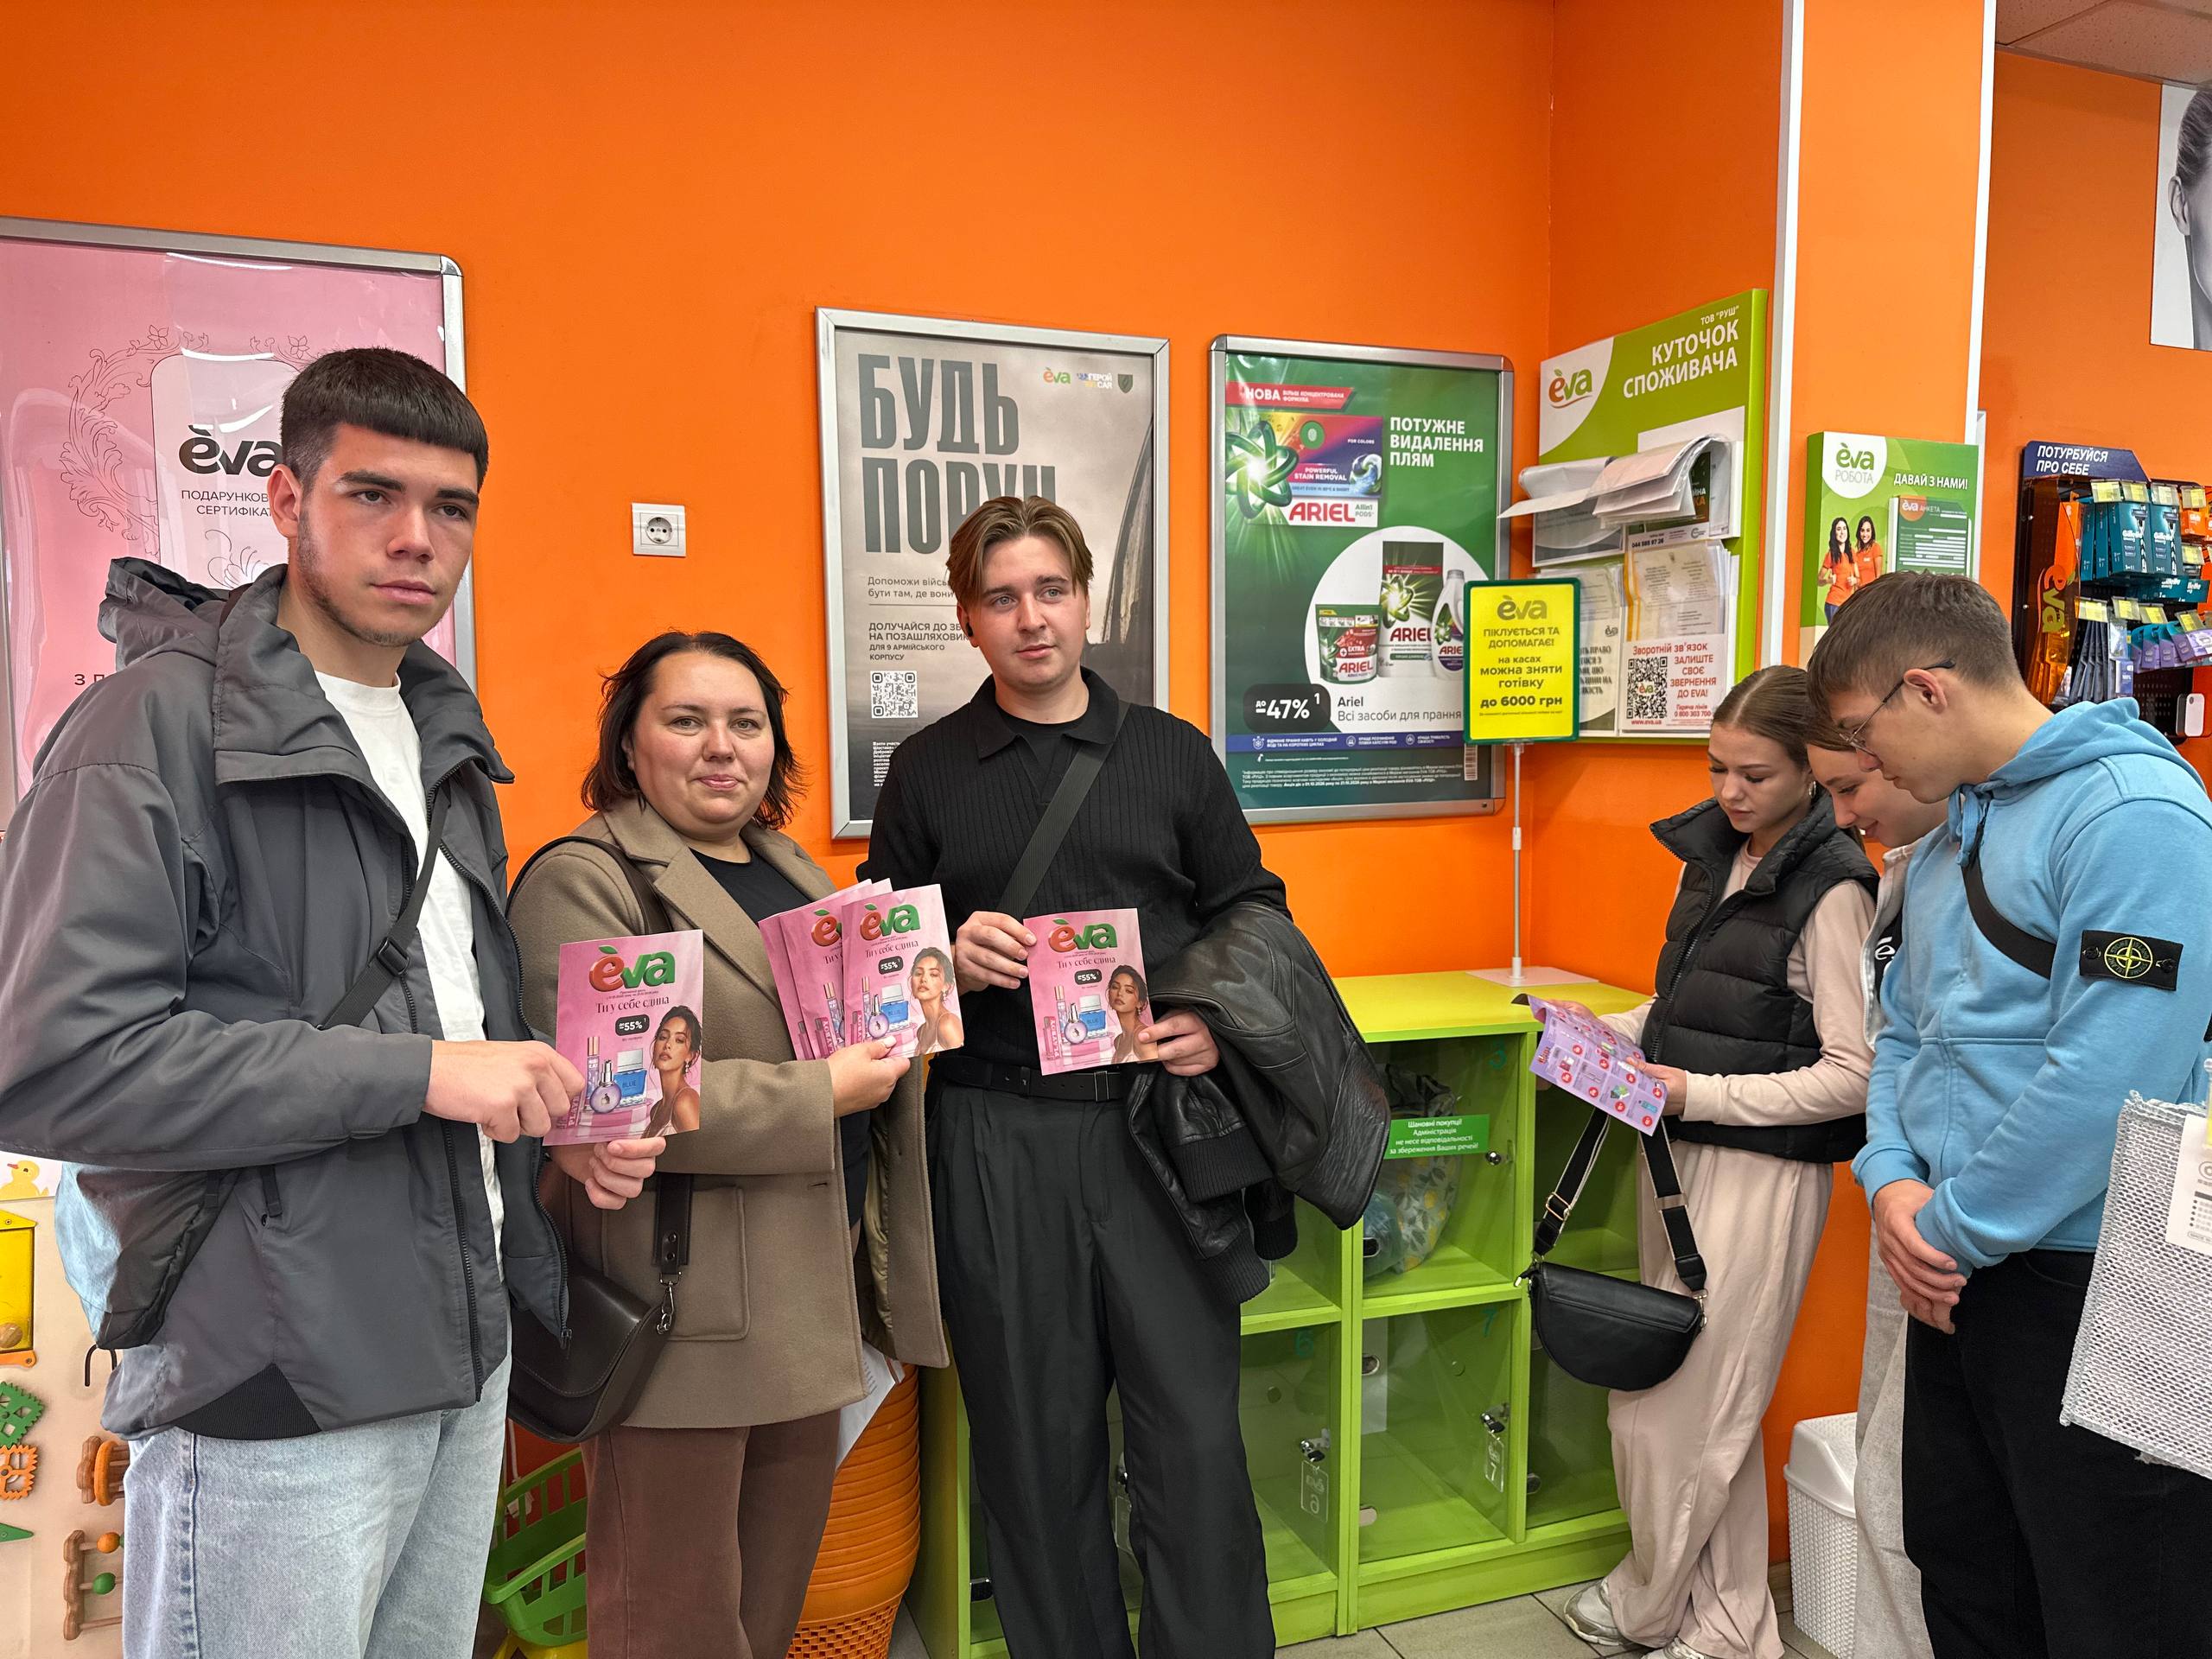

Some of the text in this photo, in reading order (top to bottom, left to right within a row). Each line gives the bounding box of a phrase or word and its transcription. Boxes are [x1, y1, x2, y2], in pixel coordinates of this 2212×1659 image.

[1700, 314, 1714, 325] ТОВ
[1652, 319, 1738, 366] КУТОЧОК
[1623, 346, 1738, 398] СПОЖИВАЧА
[1245, 388, 1281, 401] НОВА
[858, 353, 1019, 455] БУДЬ
[1389, 416, 1465, 435] ПОТУЖНЕ
[1389, 435, 1484, 453] ВИДАЛЕННЯ
[1389, 452, 1434, 468] ПЛЯМ
[2037, 445, 2108, 463] ПОТУРБУЙСЯ
[2036, 460, 2090, 476] ПРО СЕБЕ
[1834, 469, 1874, 484] РОБОТА
[1893, 473, 1968, 490] ДАВАЙ З НАМИ!
[181, 490, 269, 503] ПОДАРУНКОВ
[1289, 502, 1356, 522] ARIEL
[868, 576, 949, 587] Допоможи війсь
[868, 588, 891, 599] бути
[893, 590, 913, 599] там,
[868, 621, 931, 632] ДОЛУЧАЙСЯ
[932, 623, 948, 632] ДО
[1484, 626, 1560, 637] ПІКЛУЄТЬСЯ ТА
[869, 632, 884, 641] НА
[1489, 638, 1554, 649] ДОПОМАГАЄ!
[1632, 643, 1672, 656] Зворотній
[1439, 645, 1463, 655] ARIE
[1674, 654, 1713, 664] ЗАЛИШТЕ
[1338, 661, 1374, 673] ARIEL
[1480, 665, 1562, 676] можна зняти
[1681, 666, 1705, 676] СВОЄ
[1498, 677, 1544, 689] готівку
[1669, 677, 1717, 687] ЗВЕРНЕННЯ
[1313, 692, 1320, 705] 1
[1676, 690, 1689, 699] ДО
[1255, 700, 1267, 709] до
[1338, 696, 1364, 708] Ariel
[1480, 696, 1562, 709] до 6000 грн
[1338, 709, 1462, 721] Всі засоби для прання
[618, 999, 641, 1011] себе
